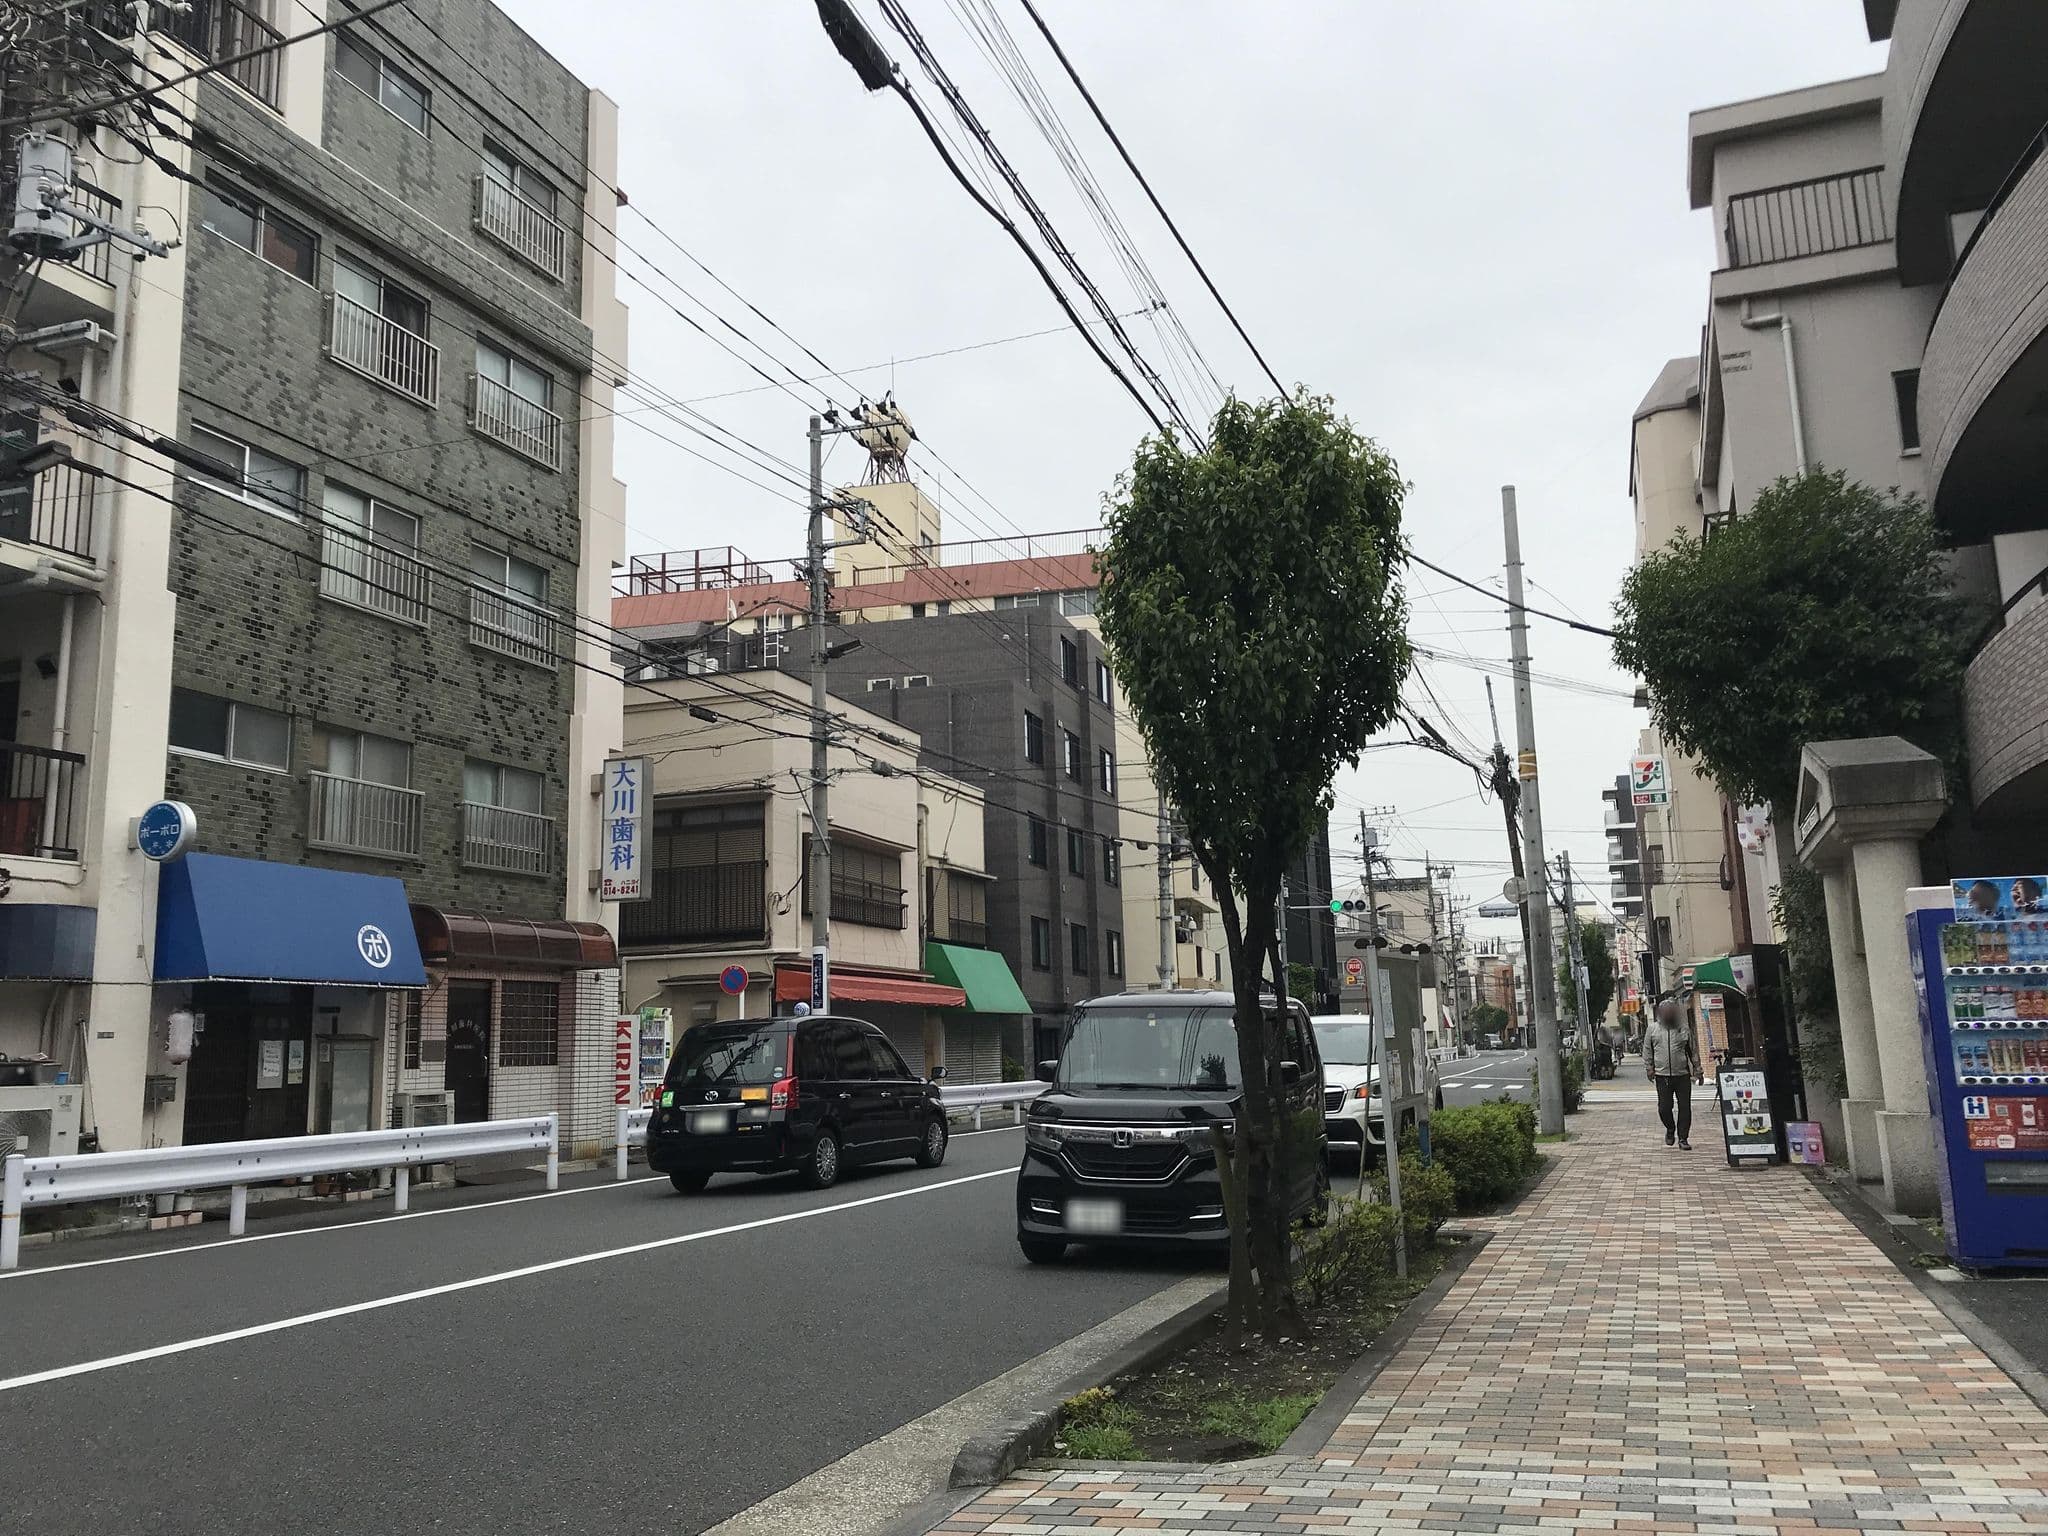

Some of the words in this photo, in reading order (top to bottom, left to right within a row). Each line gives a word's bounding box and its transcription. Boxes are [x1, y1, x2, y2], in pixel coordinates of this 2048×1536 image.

[610, 762, 636, 871] 大川歯科
[364, 933, 386, 960] ポ
[615, 1020, 632, 1105] KIRIN
[1737, 1078, 1761, 1088] Cafe
